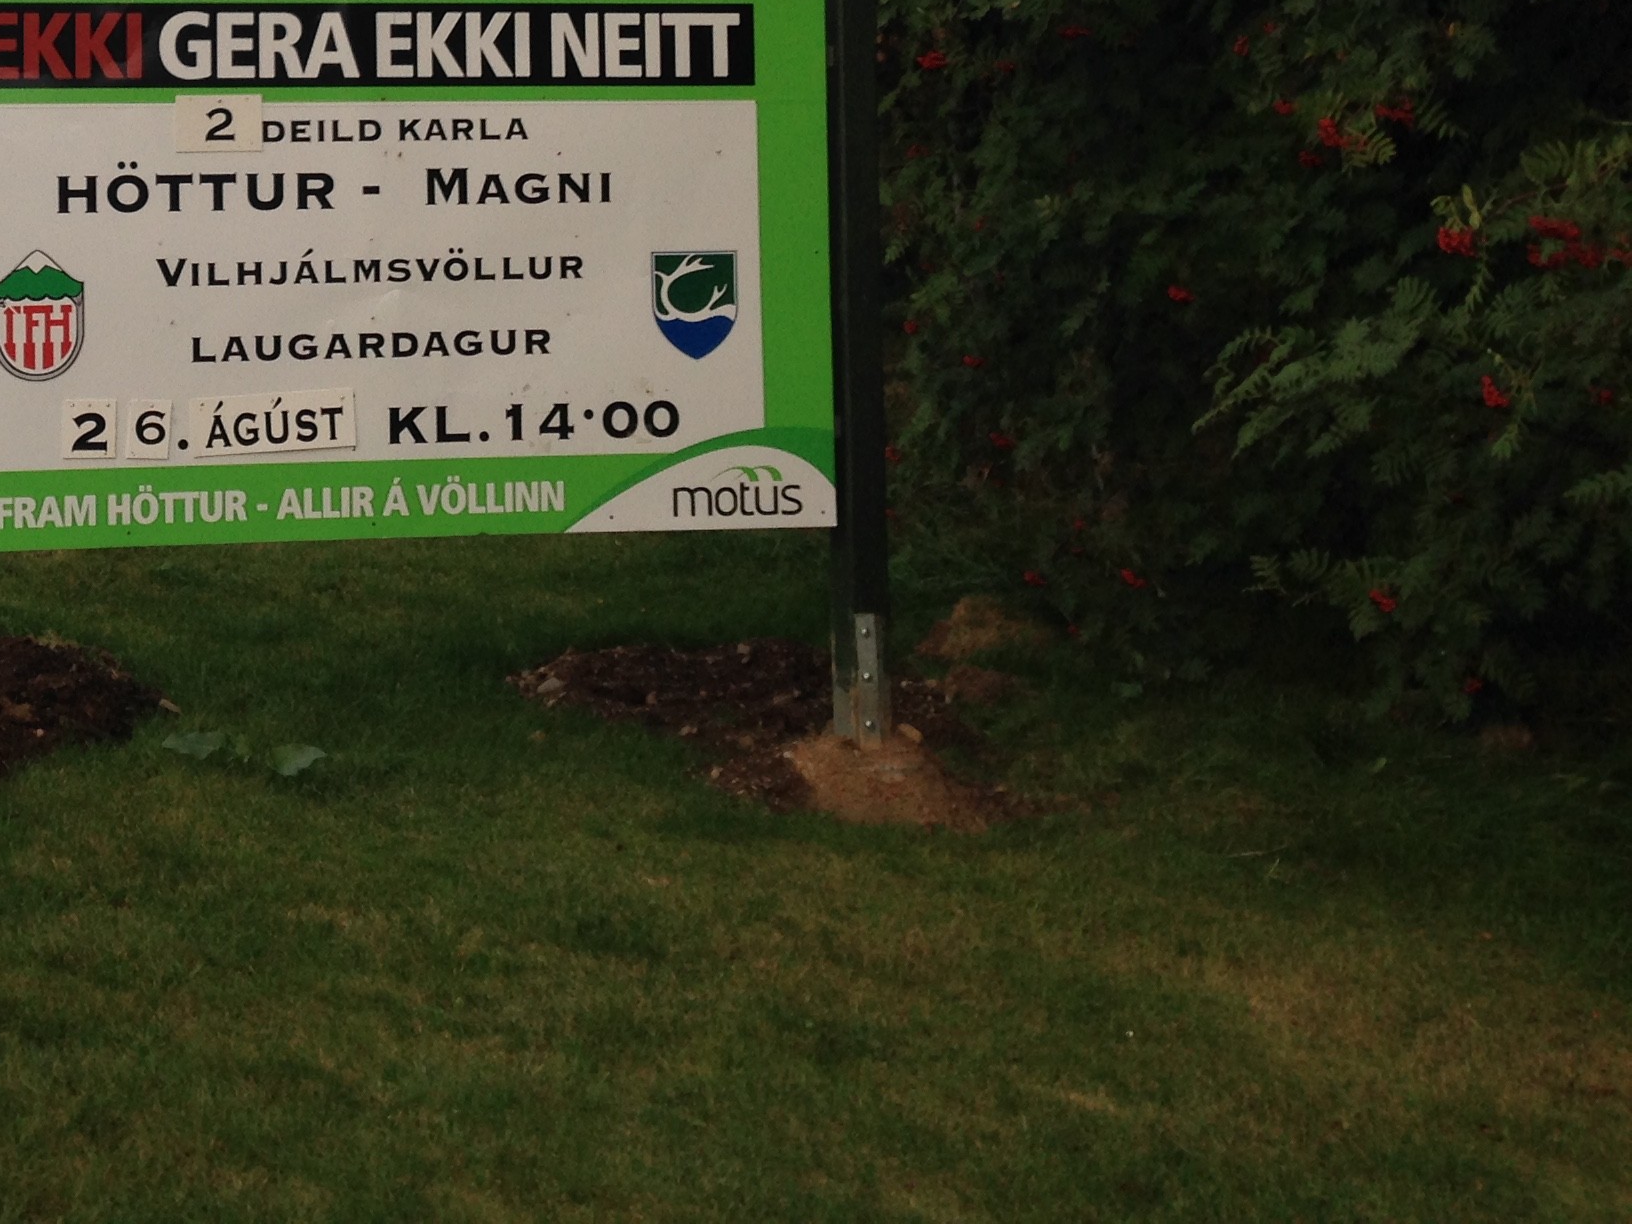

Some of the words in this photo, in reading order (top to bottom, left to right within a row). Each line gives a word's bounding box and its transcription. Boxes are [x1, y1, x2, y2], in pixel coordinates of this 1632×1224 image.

[158, 11, 360, 80] GERA
[375, 11, 531, 78] EKKI
[550, 12, 741, 78] NEITT
[205, 107, 236, 142] 2
[261, 118, 382, 143] DEILD
[398, 118, 529, 142] KARLA
[56, 160, 335, 214] HÖTTUR
[191, 328, 551, 363] LAUGARDAGUR
[205, 396, 344, 449] ÁGÚST
[107, 484, 248, 526] HÖTTUR
[276, 485, 375, 520] ALLIR
[382, 477, 410, 517] Á
[416, 475, 565, 516] VÖLLINN
[672, 480, 803, 518] motus
